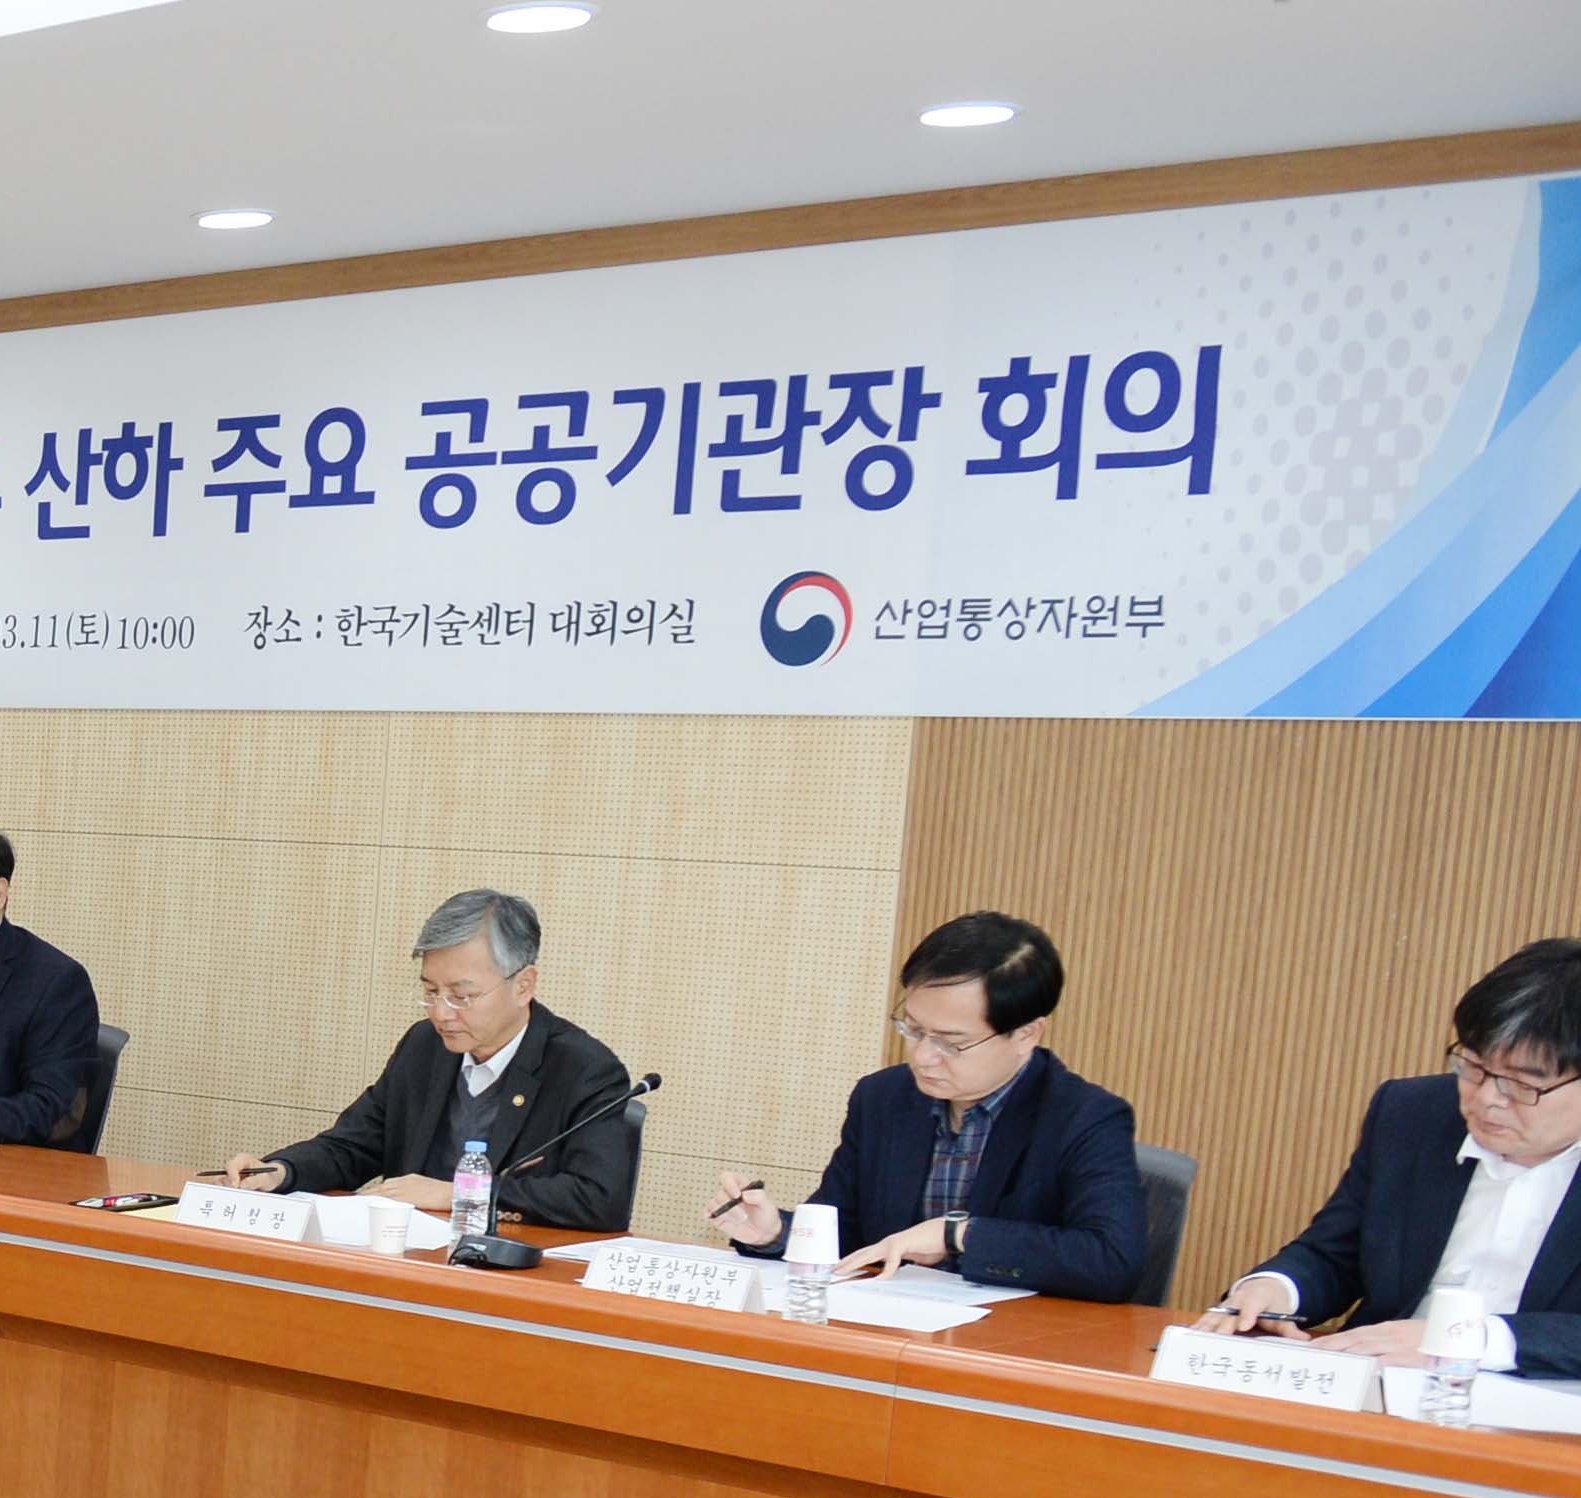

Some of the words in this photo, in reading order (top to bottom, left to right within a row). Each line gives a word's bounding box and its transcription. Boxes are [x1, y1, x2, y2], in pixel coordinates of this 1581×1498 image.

[23, 420, 184, 541] 산하
[202, 406, 376, 535] 주요
[403, 365, 943, 530] 공공기관장
[964, 344, 1223, 502] 회의
[243, 604, 303, 651] 장소
[334, 600, 535, 648] 한국기술센터
[548, 598, 697, 647] 대회의실
[873, 594, 1166, 642] 산업통상자원부
[608, 1252, 738, 1287] 산업통상자원부
